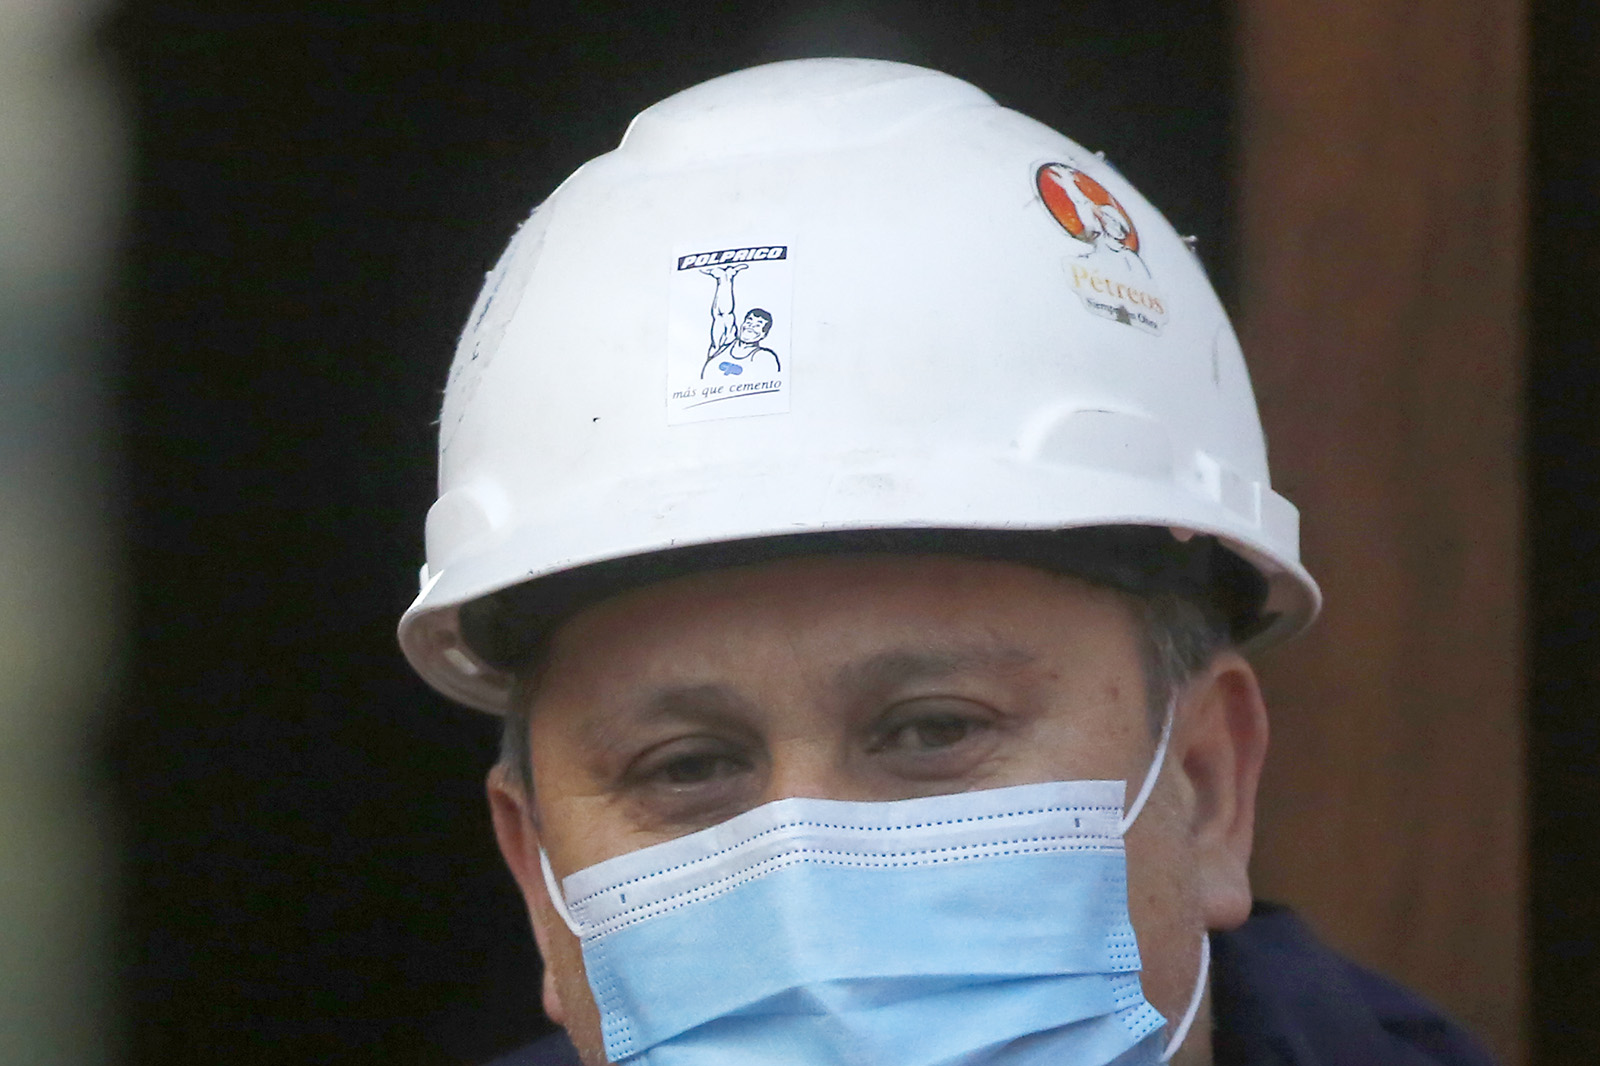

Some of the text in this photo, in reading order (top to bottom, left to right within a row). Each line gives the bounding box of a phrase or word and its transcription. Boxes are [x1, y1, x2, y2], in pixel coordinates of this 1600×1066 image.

[672, 379, 782, 400] más que cemento
